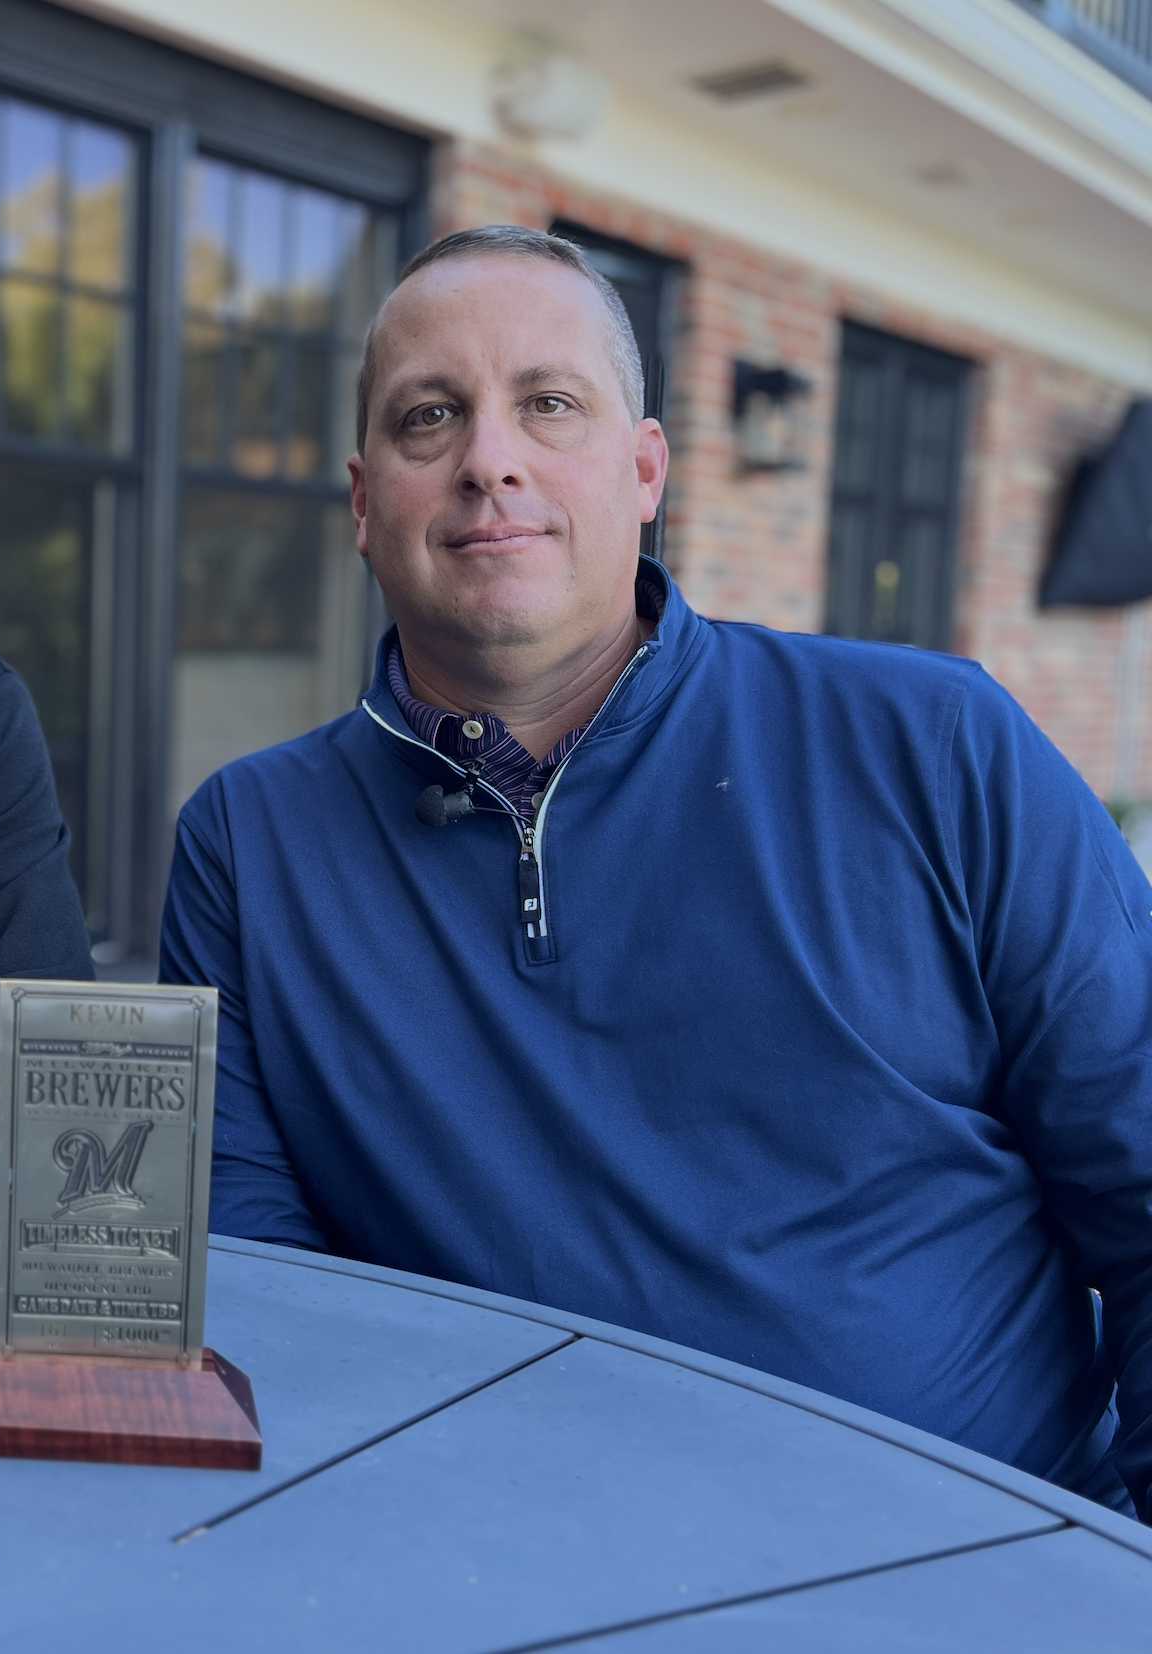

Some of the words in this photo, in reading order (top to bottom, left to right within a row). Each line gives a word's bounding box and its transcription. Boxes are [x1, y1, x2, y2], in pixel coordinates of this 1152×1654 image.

[70, 1003, 144, 1025] KEVIN
[26, 1060, 186, 1074] MILWAUKEE
[25, 1071, 186, 1112] BREWERS
[26, 1223, 108, 1244] TIMELESS
[111, 1227, 173, 1249] TICKET
[22, 1261, 103, 1275] MILWAUKEE
[109, 1266, 174, 1278] BREWERS
[18, 1297, 58, 1313] GAME
[60, 1298, 97, 1315] DATE
[99, 1300, 112, 1316] &
[112, 1300, 147, 1318] TIME
[149, 1303, 179, 1318] TBD
[39, 1323, 67, 1337] 161
[103, 1326, 159, 1342] $1000
